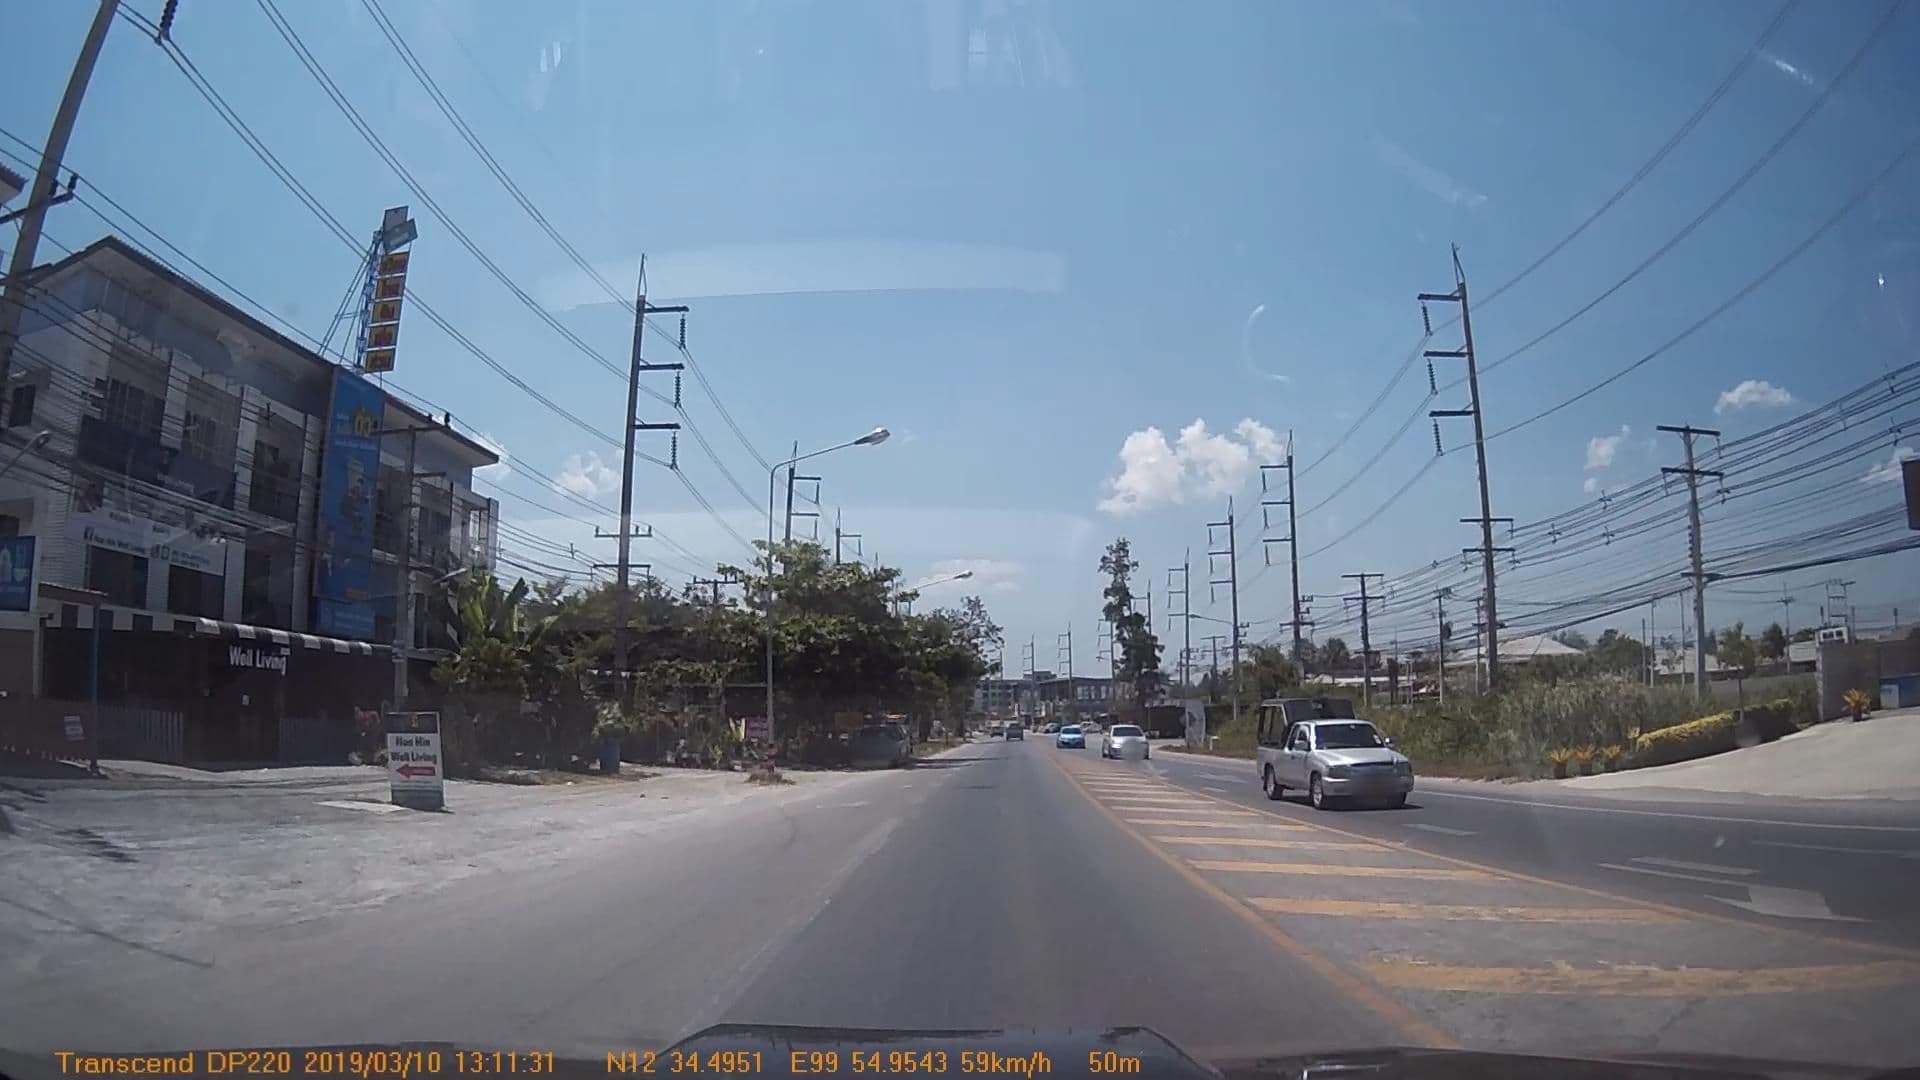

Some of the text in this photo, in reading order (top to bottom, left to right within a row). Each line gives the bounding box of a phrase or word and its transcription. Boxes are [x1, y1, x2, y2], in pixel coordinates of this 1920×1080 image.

[229, 645, 287, 676] Well Living
[391, 751, 437, 765] Well Living
